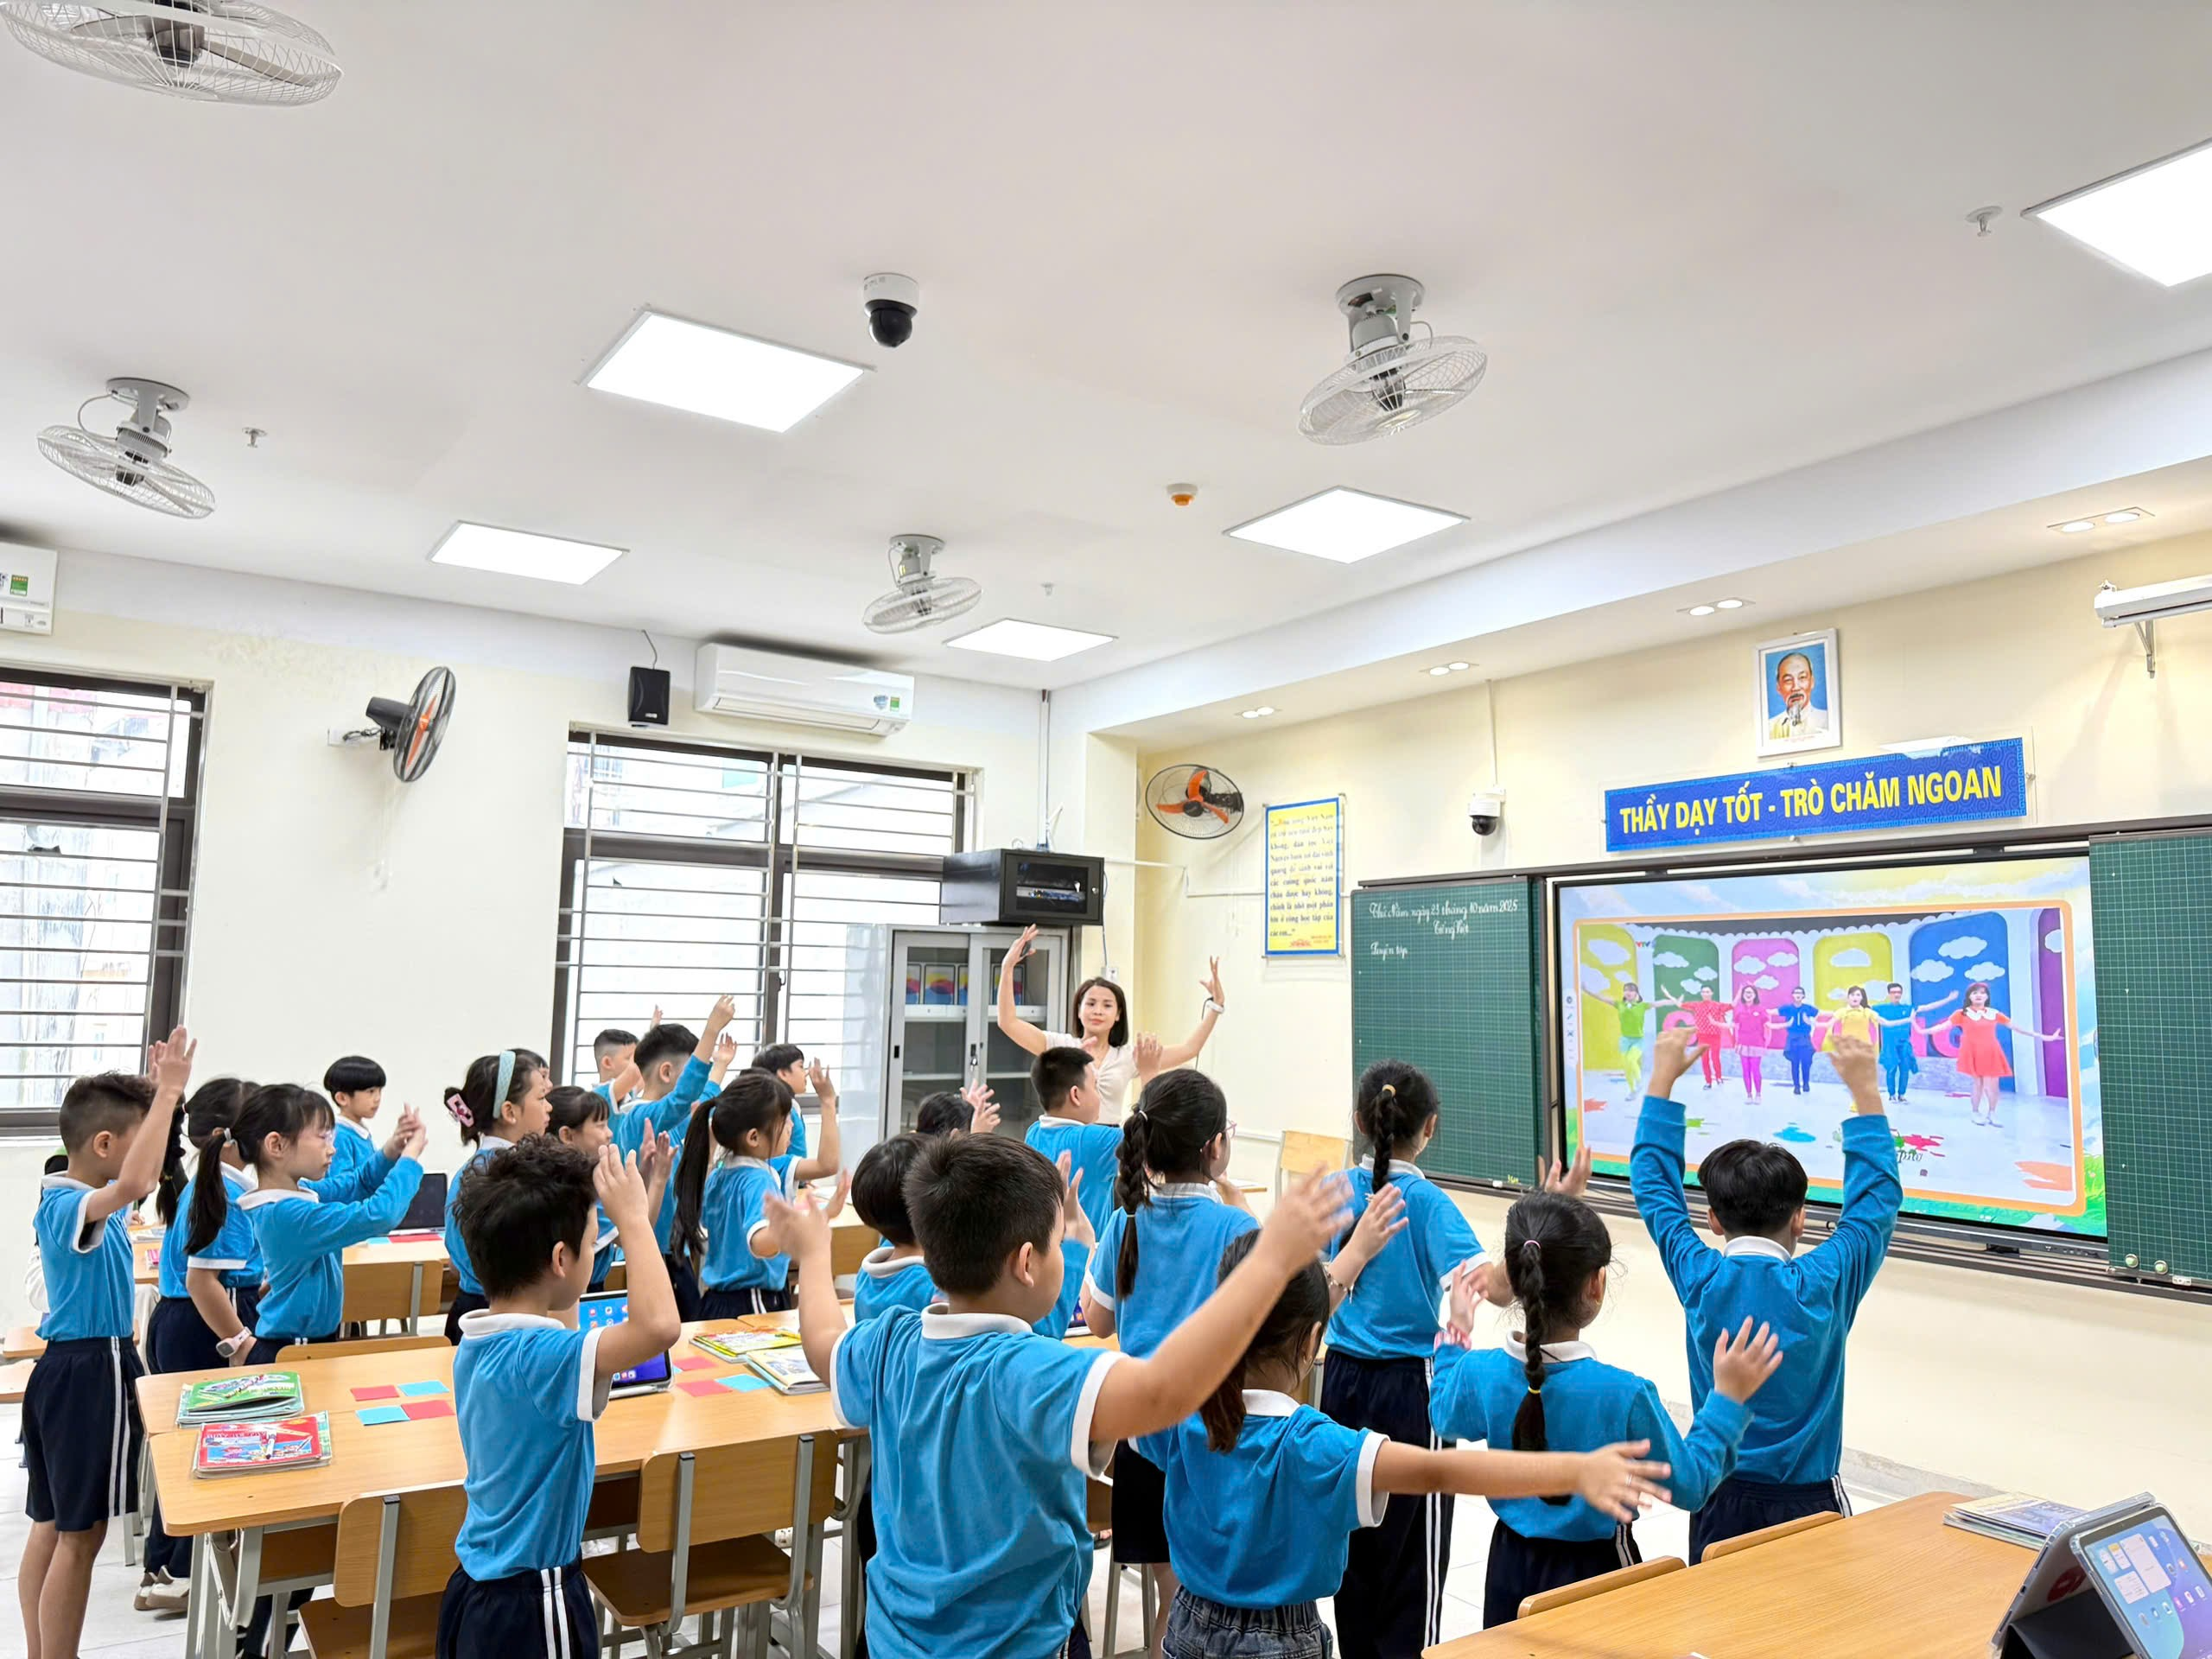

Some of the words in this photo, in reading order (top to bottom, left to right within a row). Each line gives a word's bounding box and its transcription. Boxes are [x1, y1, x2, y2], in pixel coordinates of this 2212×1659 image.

[1619, 793, 1670, 834] THẦY
[1675, 797, 1718, 836] DẠY
[1722, 780, 1764, 823] TỐT
[1768, 804, 1777, 813] -
[1780, 779, 1825, 818] TRÒ
[1830, 771, 1900, 814] CHĂM
[1907, 766, 2002, 806] NGOAN
[1412, 906, 1431, 924] ngày
[1441, 899, 1468, 920] tháng
[1499, 899, 1519, 912] 2025
